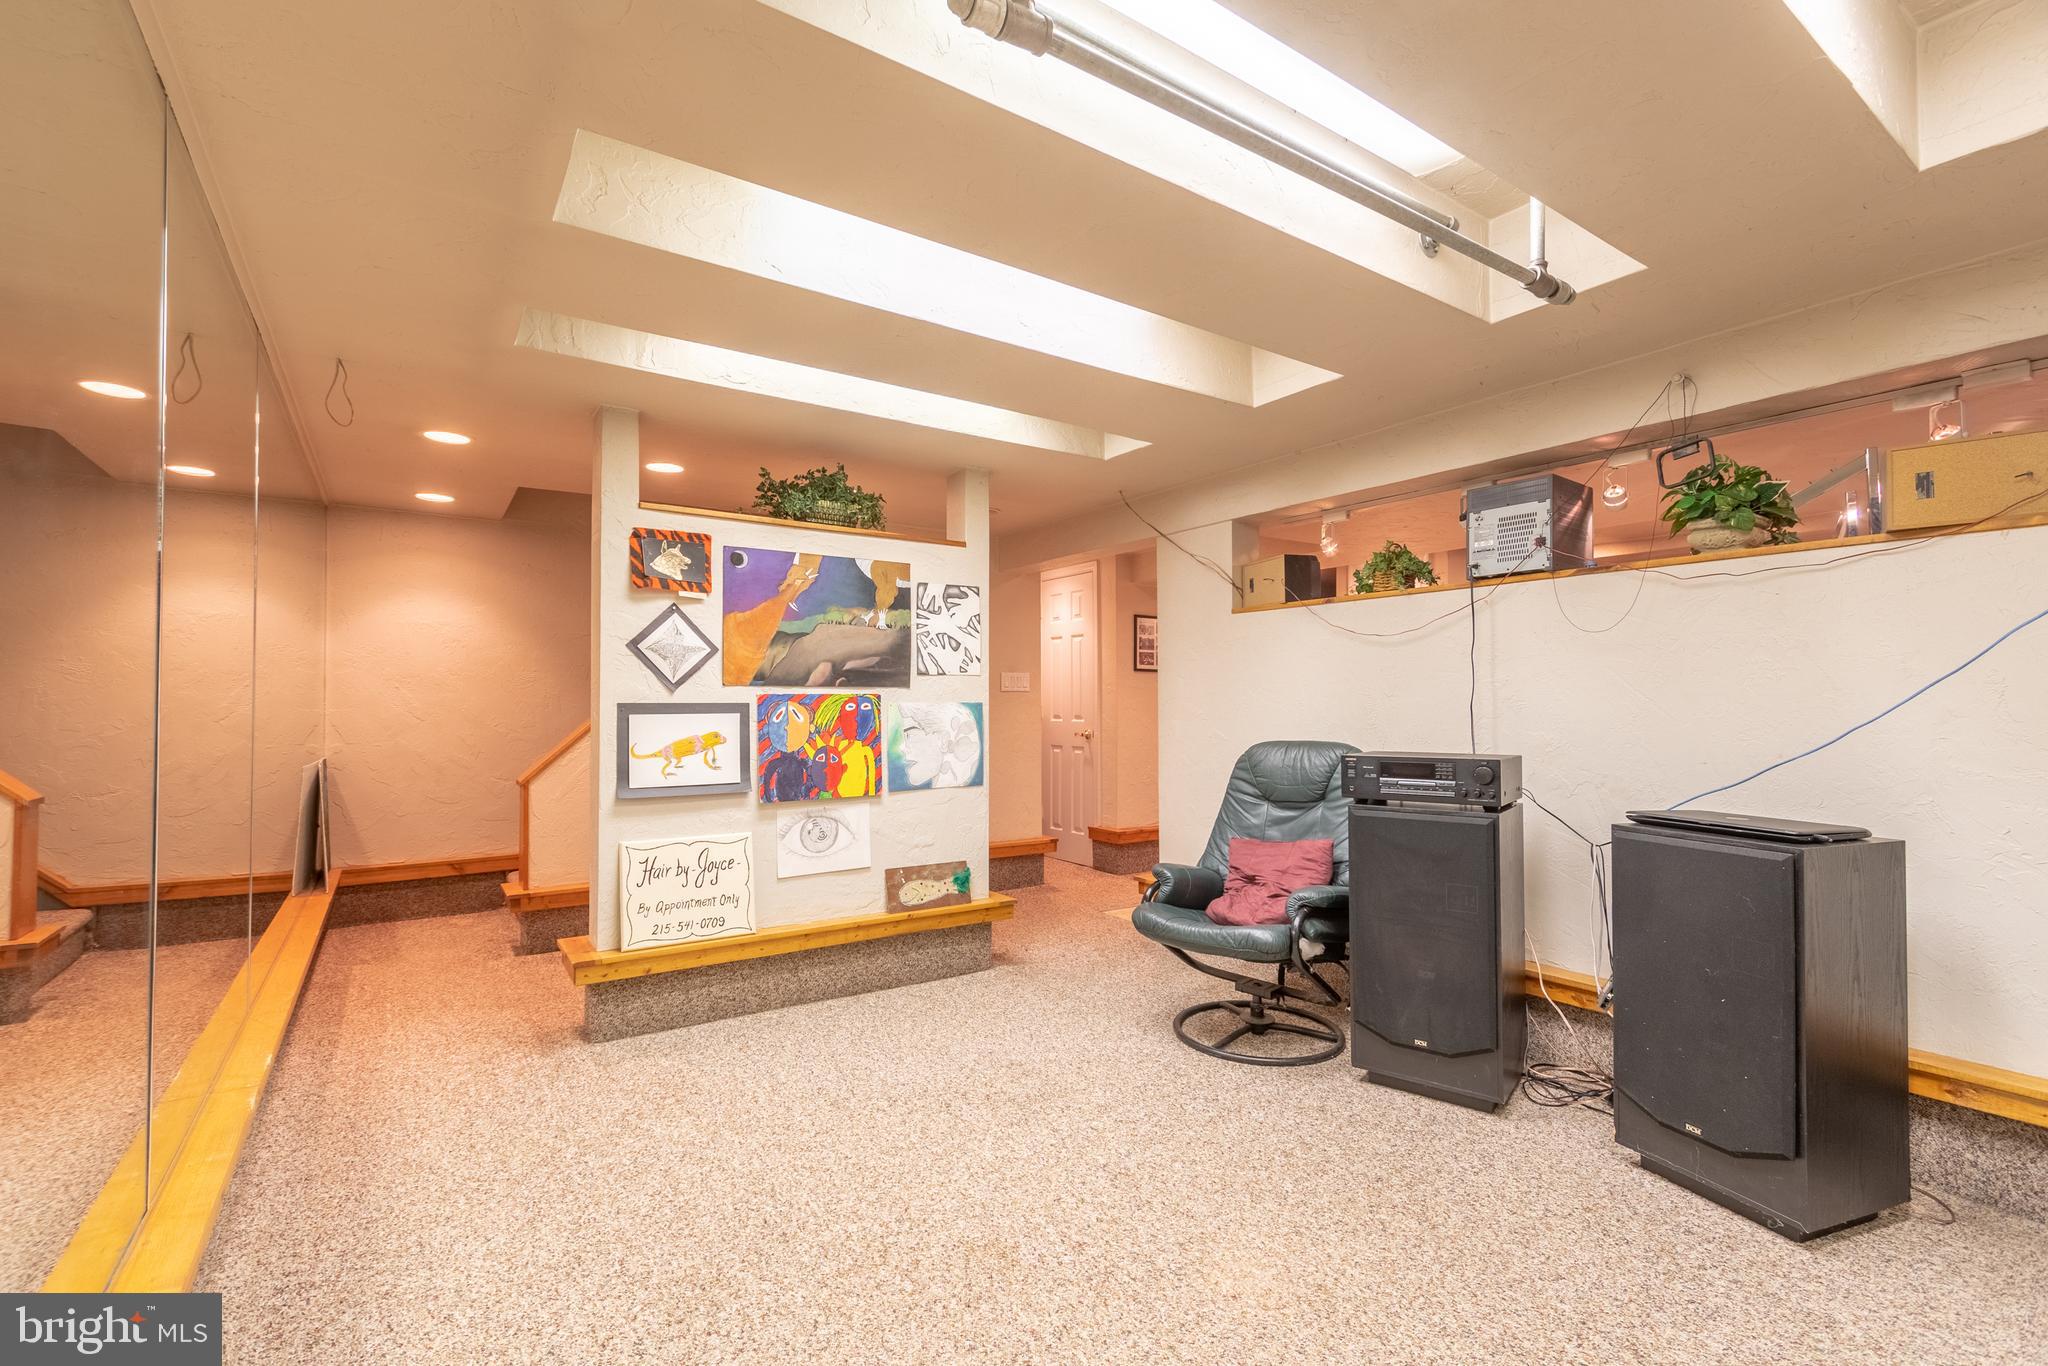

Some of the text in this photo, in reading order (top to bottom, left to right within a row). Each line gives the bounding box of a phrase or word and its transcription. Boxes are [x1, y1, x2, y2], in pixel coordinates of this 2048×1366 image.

[636, 856, 672, 888] Hair
[675, 858, 690, 888] by
[637, 893, 740, 918] By Appointment Only
[651, 916, 726, 936] 215-541-0709
